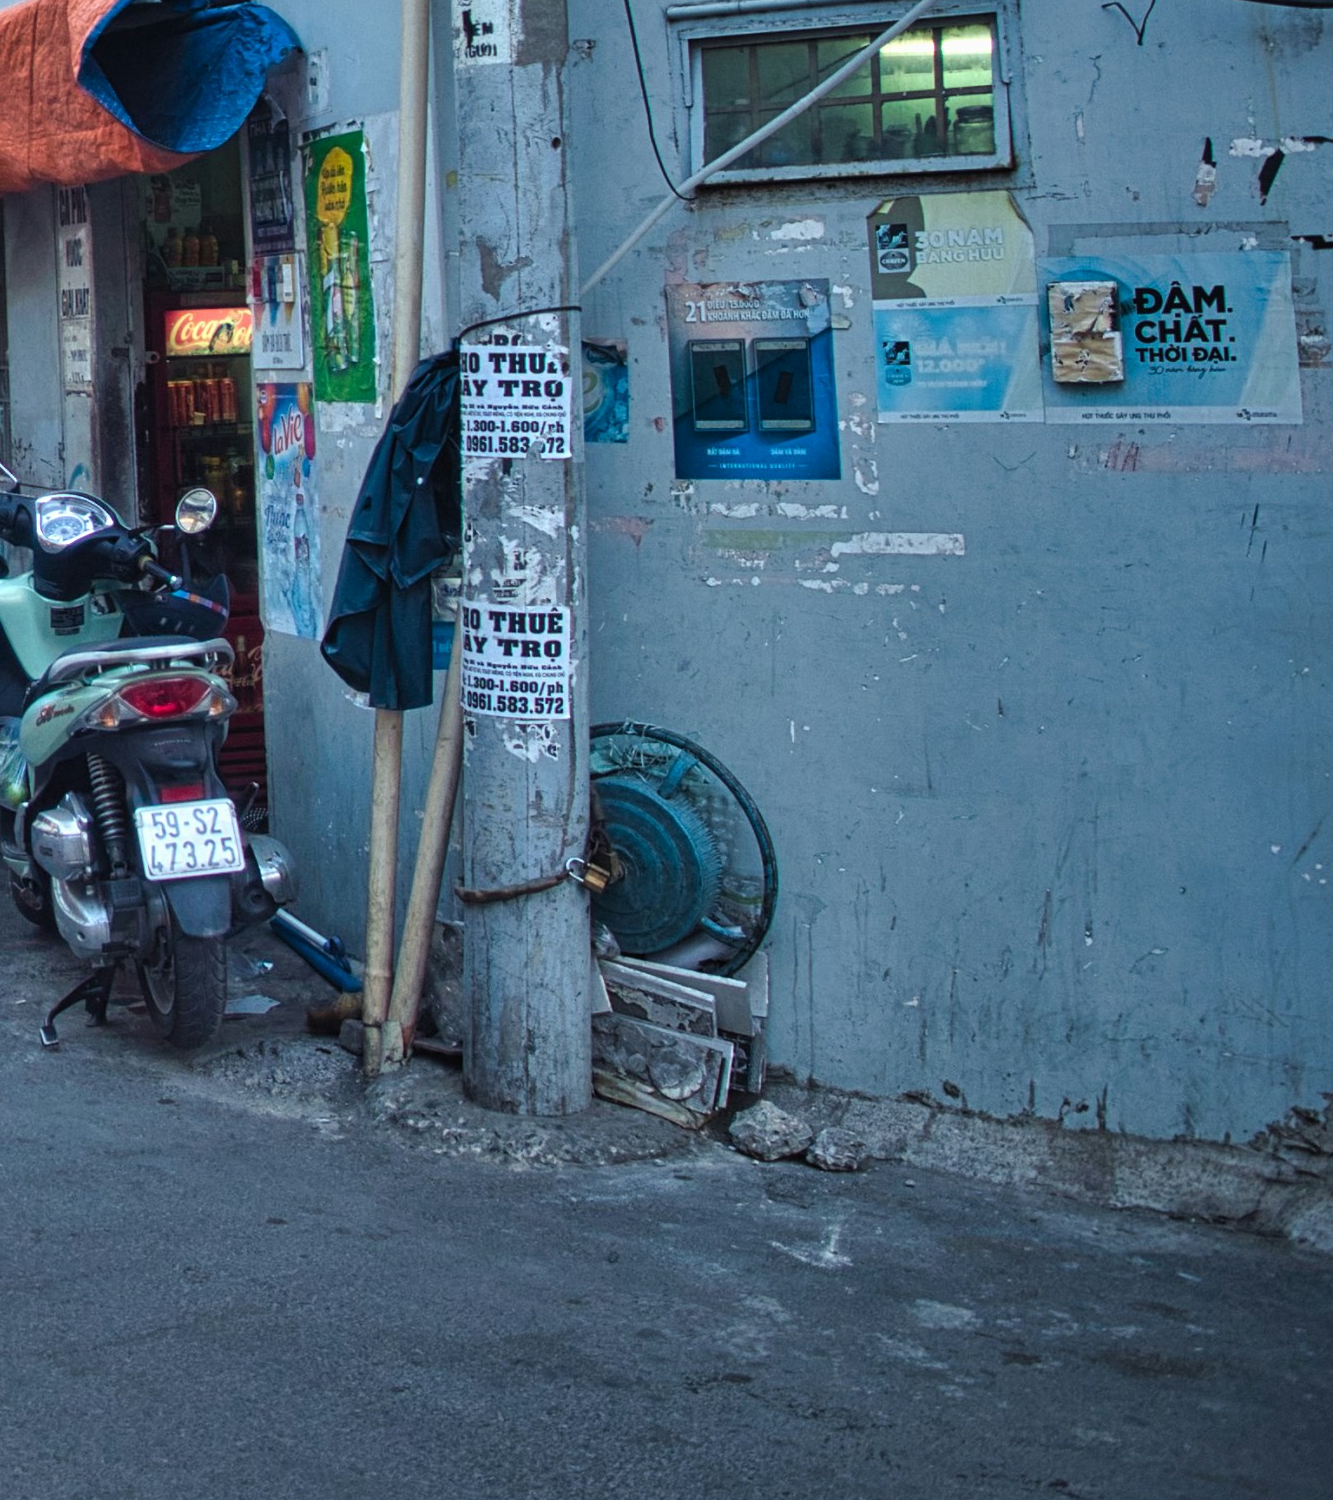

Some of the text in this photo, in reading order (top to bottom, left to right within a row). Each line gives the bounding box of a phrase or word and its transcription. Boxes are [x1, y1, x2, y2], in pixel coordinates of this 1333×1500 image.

[915, 229, 944, 249] 30
[1134, 280, 1234, 317] ĐẬM.
[685, 301, 707, 323] 21
[1134, 313, 1236, 344] CHẤT.
[460, 352, 481, 374] HO
[1136, 345, 1238, 364] THỜI ĐẠI.
[1147, 366, 1164, 375] 30
[497, 379, 564, 402] TRỌ
[463, 605, 564, 634] HO THUÊ
[464, 629, 488, 654] ÃY
[497, 638, 563, 663] TRỌ
[466, 692, 565, 715] 0961.583.572
[151, 806, 223, 840] 59-S2
[150, 836, 237, 873] 473.25
